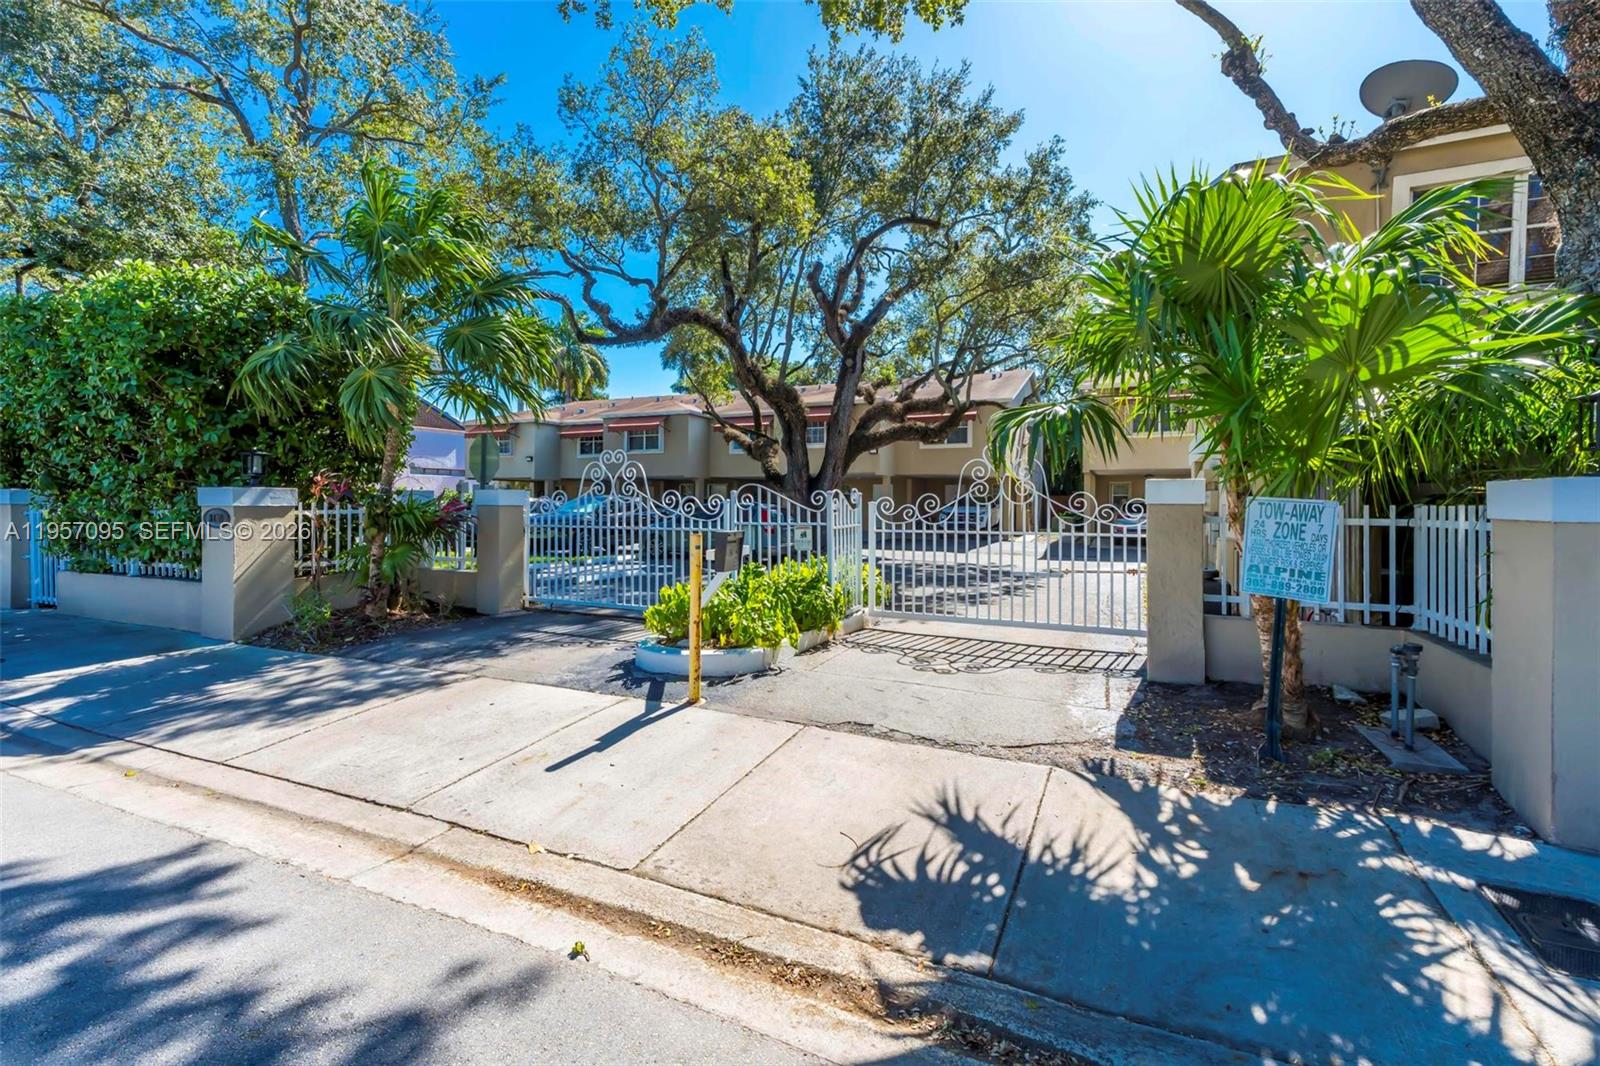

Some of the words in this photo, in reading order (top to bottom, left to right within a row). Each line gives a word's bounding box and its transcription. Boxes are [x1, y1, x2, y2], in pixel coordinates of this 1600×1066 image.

[1257, 502, 1325, 523] TOW-AWAY
[1253, 519, 1265, 528] 24
[1317, 524, 1324, 532] 7
[1251, 528, 1267, 537] HRS
[1272, 521, 1307, 541] ZONE
[1311, 533, 1328, 543] DAYS
[1247, 564, 1326, 582] ALPINE
